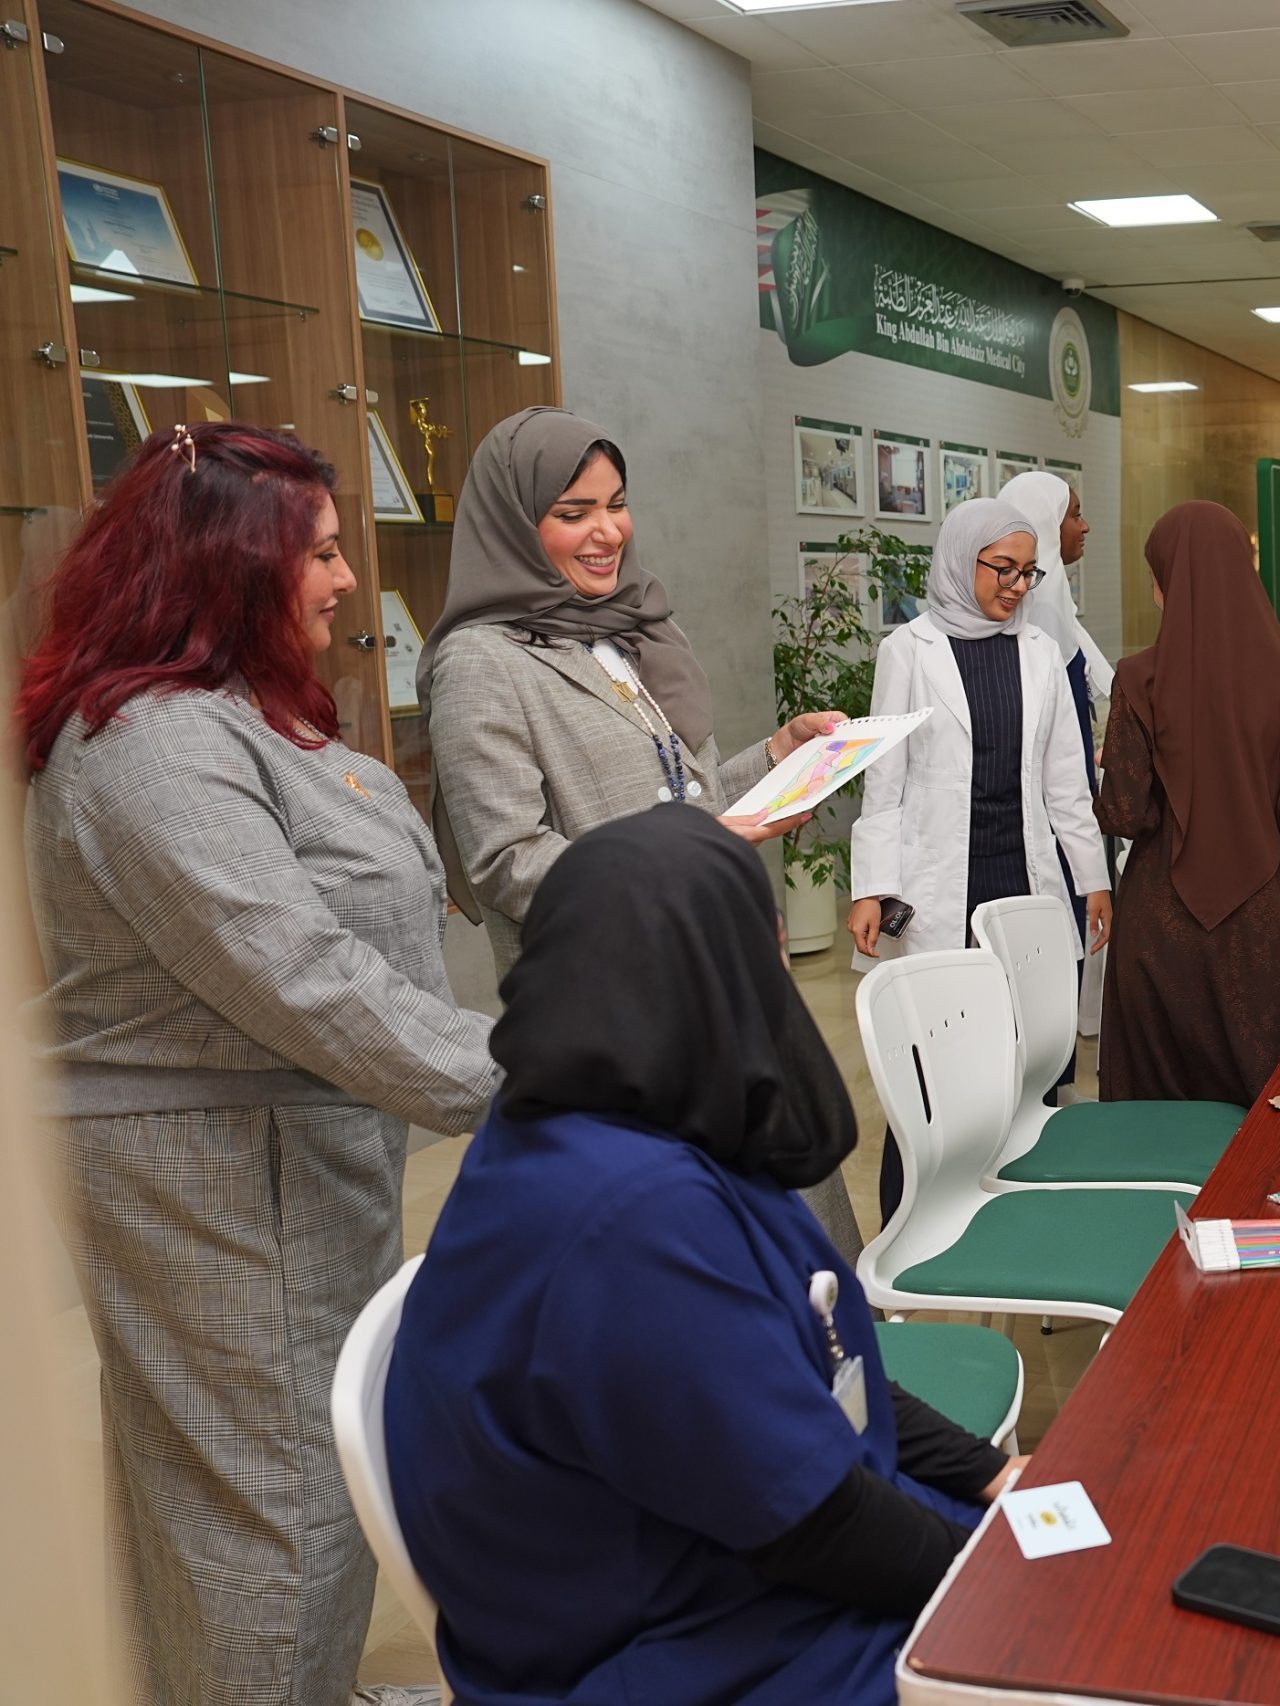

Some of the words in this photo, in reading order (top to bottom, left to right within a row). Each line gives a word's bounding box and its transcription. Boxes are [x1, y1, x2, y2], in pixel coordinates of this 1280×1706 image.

[876, 313, 897, 344] King
[899, 321, 935, 349] Abdullah
[936, 331, 950, 353] Bin
[950, 336, 985, 363] Abdulaziz
[985, 346, 1011, 372] Medical
[1012, 354, 1025, 378] City
